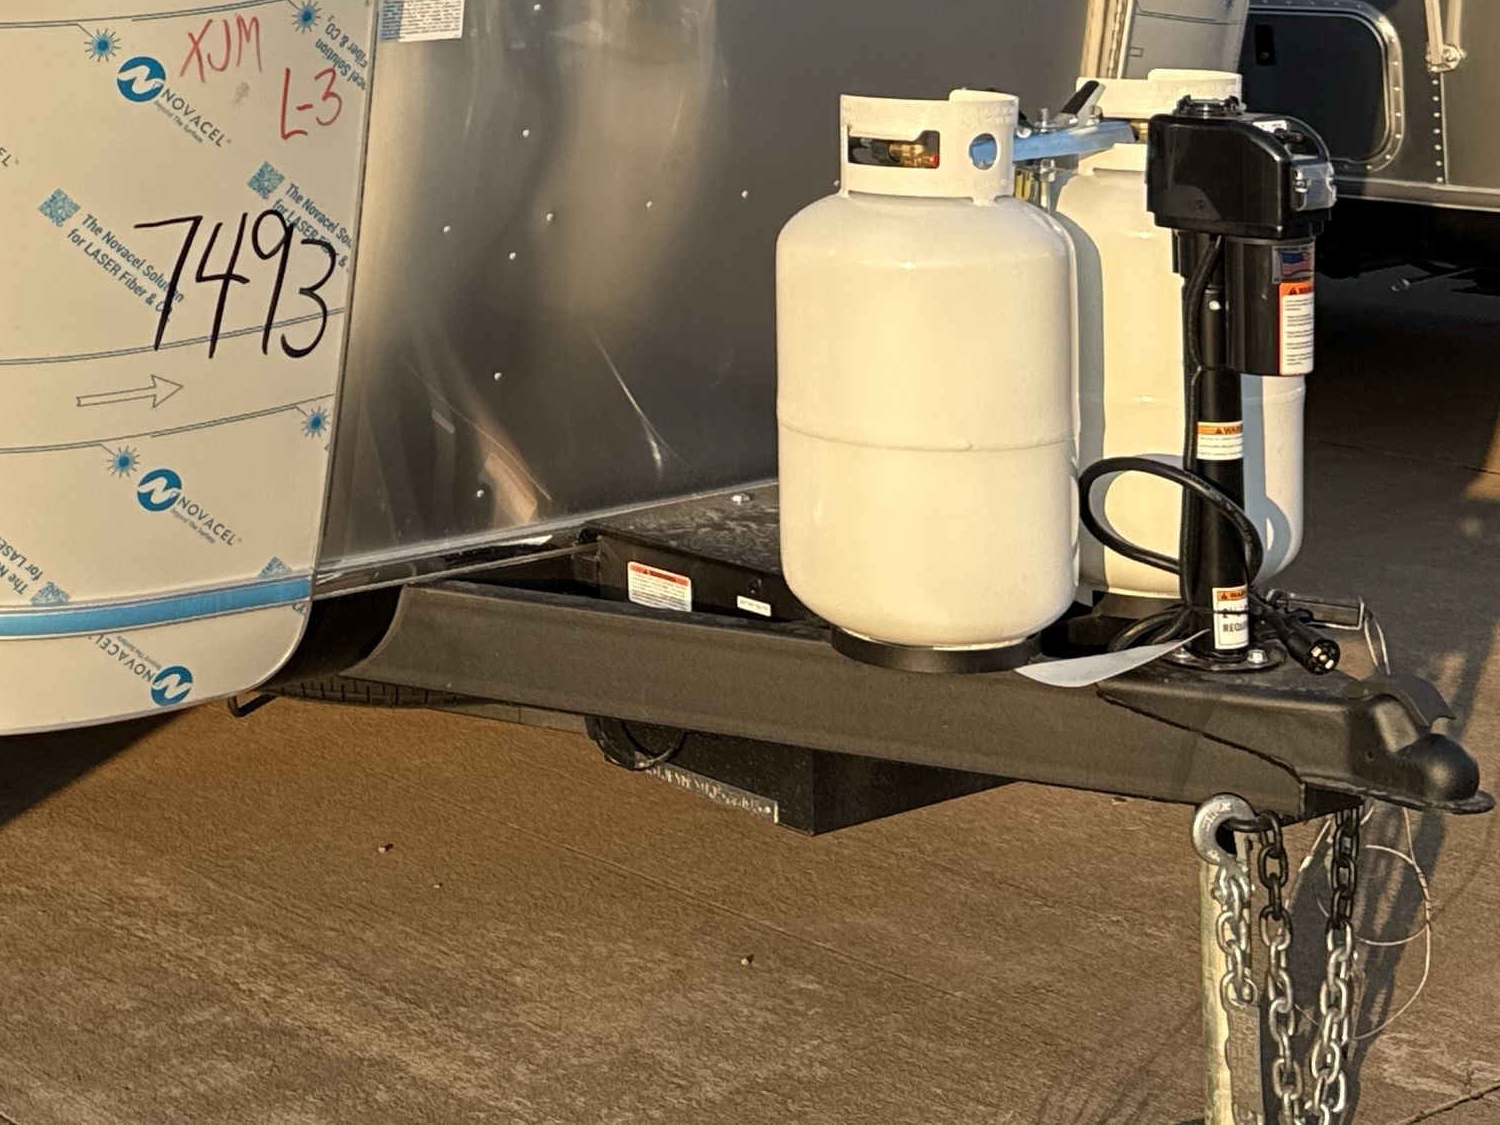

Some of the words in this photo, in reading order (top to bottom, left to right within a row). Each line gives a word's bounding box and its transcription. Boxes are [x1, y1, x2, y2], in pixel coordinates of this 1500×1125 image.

[179, 13, 263, 83] XJM
[315, 39, 351, 76] Solution
[339, 34, 349, 48] &
[347, 42, 368, 68] Fiber
[160, 87, 225, 147] NOVACEL
[281, 67, 343, 140] L-3
[286, 182, 303, 204] The
[302, 198, 340, 233] Novacel
[66, 228, 86, 247] for
[84, 242, 122, 276] LASER
[118, 271, 147, 297] Fiber
[144, 293, 157, 306] &
[82, 214, 103, 236] The
[101, 231, 147, 269] Novacel
[142, 265, 185, 303] Soluon
[133, 209, 336, 359] 7493
[177, 496, 236, 546] NOVACEL
[7, 573, 29, 595] The
[24, 563, 43, 581] for
[95, 634, 156, 683] NOVACEL
